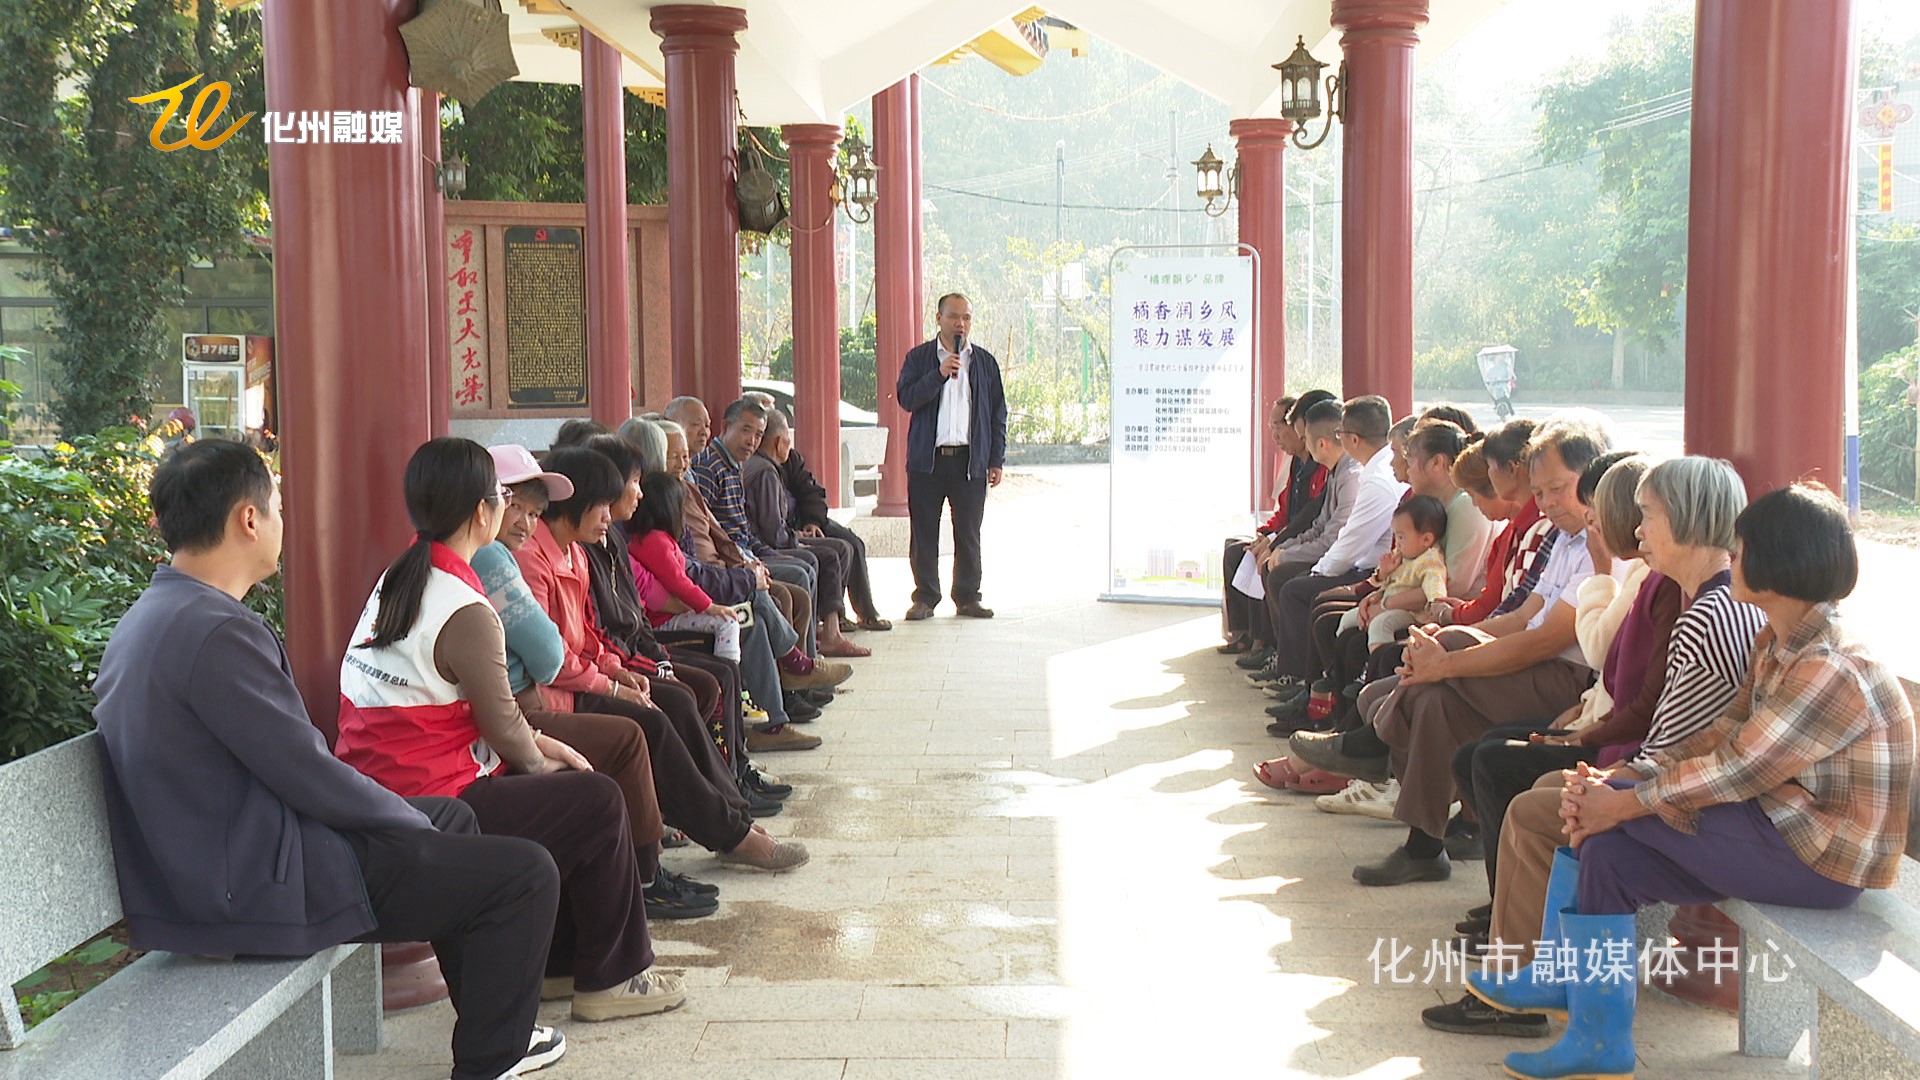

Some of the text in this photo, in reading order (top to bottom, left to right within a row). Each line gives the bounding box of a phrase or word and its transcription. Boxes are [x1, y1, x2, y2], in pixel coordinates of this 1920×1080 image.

[1132, 300, 1237, 321] 橘香润乡风
[1132, 327, 1236, 347] 聚力谋发展
